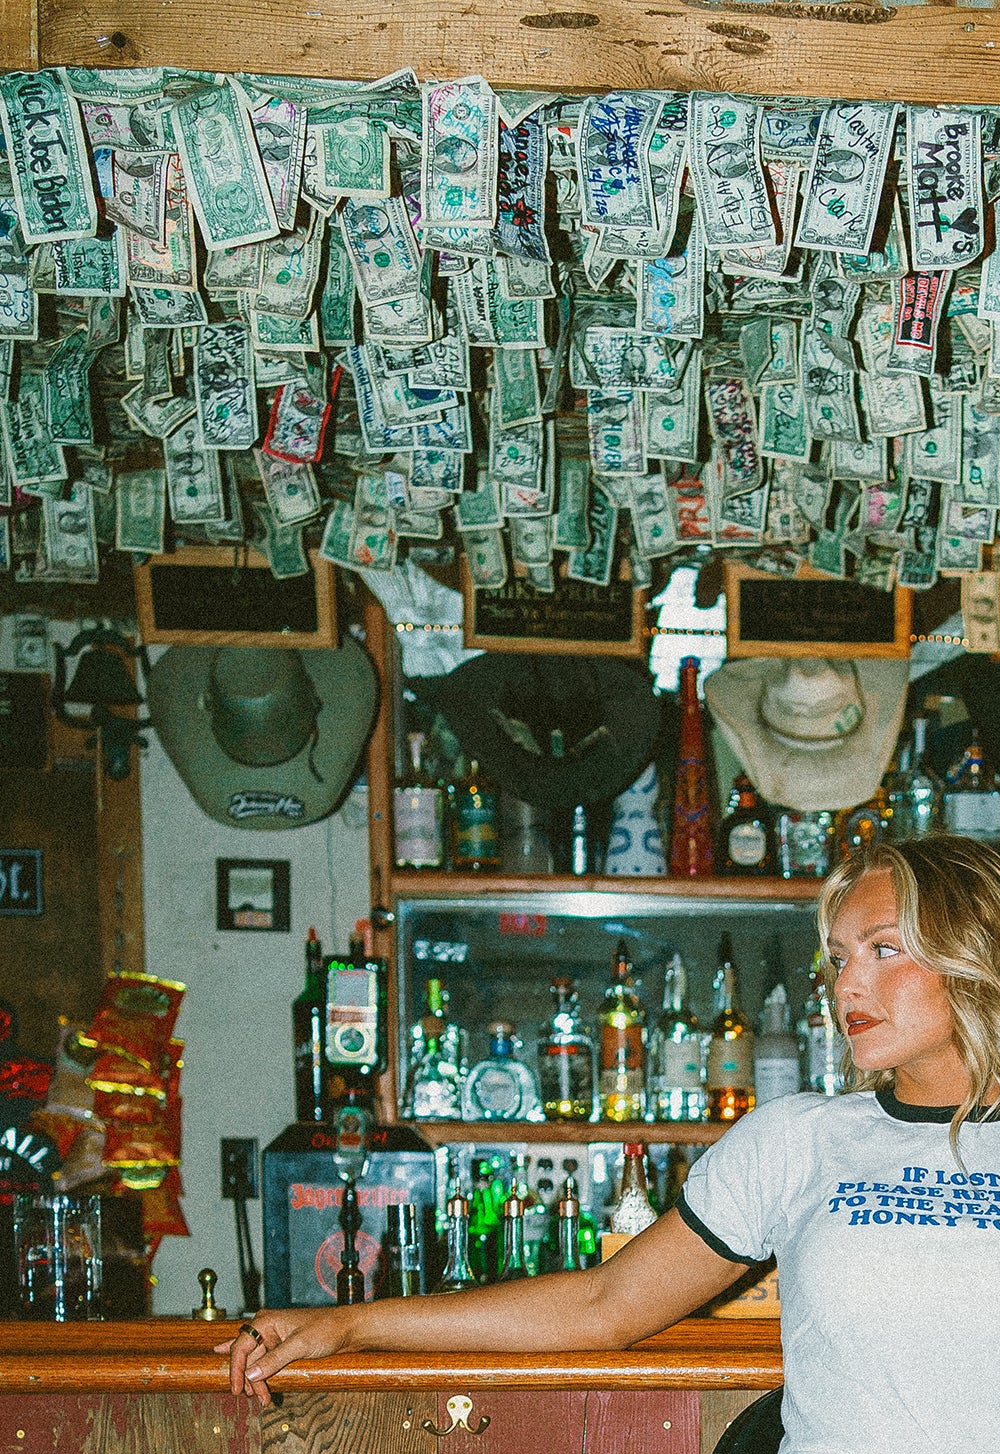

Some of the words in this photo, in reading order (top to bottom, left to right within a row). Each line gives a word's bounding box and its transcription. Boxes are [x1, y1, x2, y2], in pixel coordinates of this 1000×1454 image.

[29, 130, 67, 174] Joe
[837, 105, 880, 159] Clayton
[944, 123, 967, 201] Brooke
[33, 174, 71, 233] Biden
[818, 187, 862, 233] Clark
[911, 141, 950, 243] Matt
[913, 277, 928, 320] DEVILS
[927, 276, 940, 320] SUPPORT
[835, 1181, 945, 1199] PLEASE
[902, 1166, 929, 1183] IF
[935, 1169, 1000, 1188] LOST
[828, 1195, 867, 1214] TO
[876, 1194, 934, 1212] THE
[848, 1208, 961, 1227] HONKY
